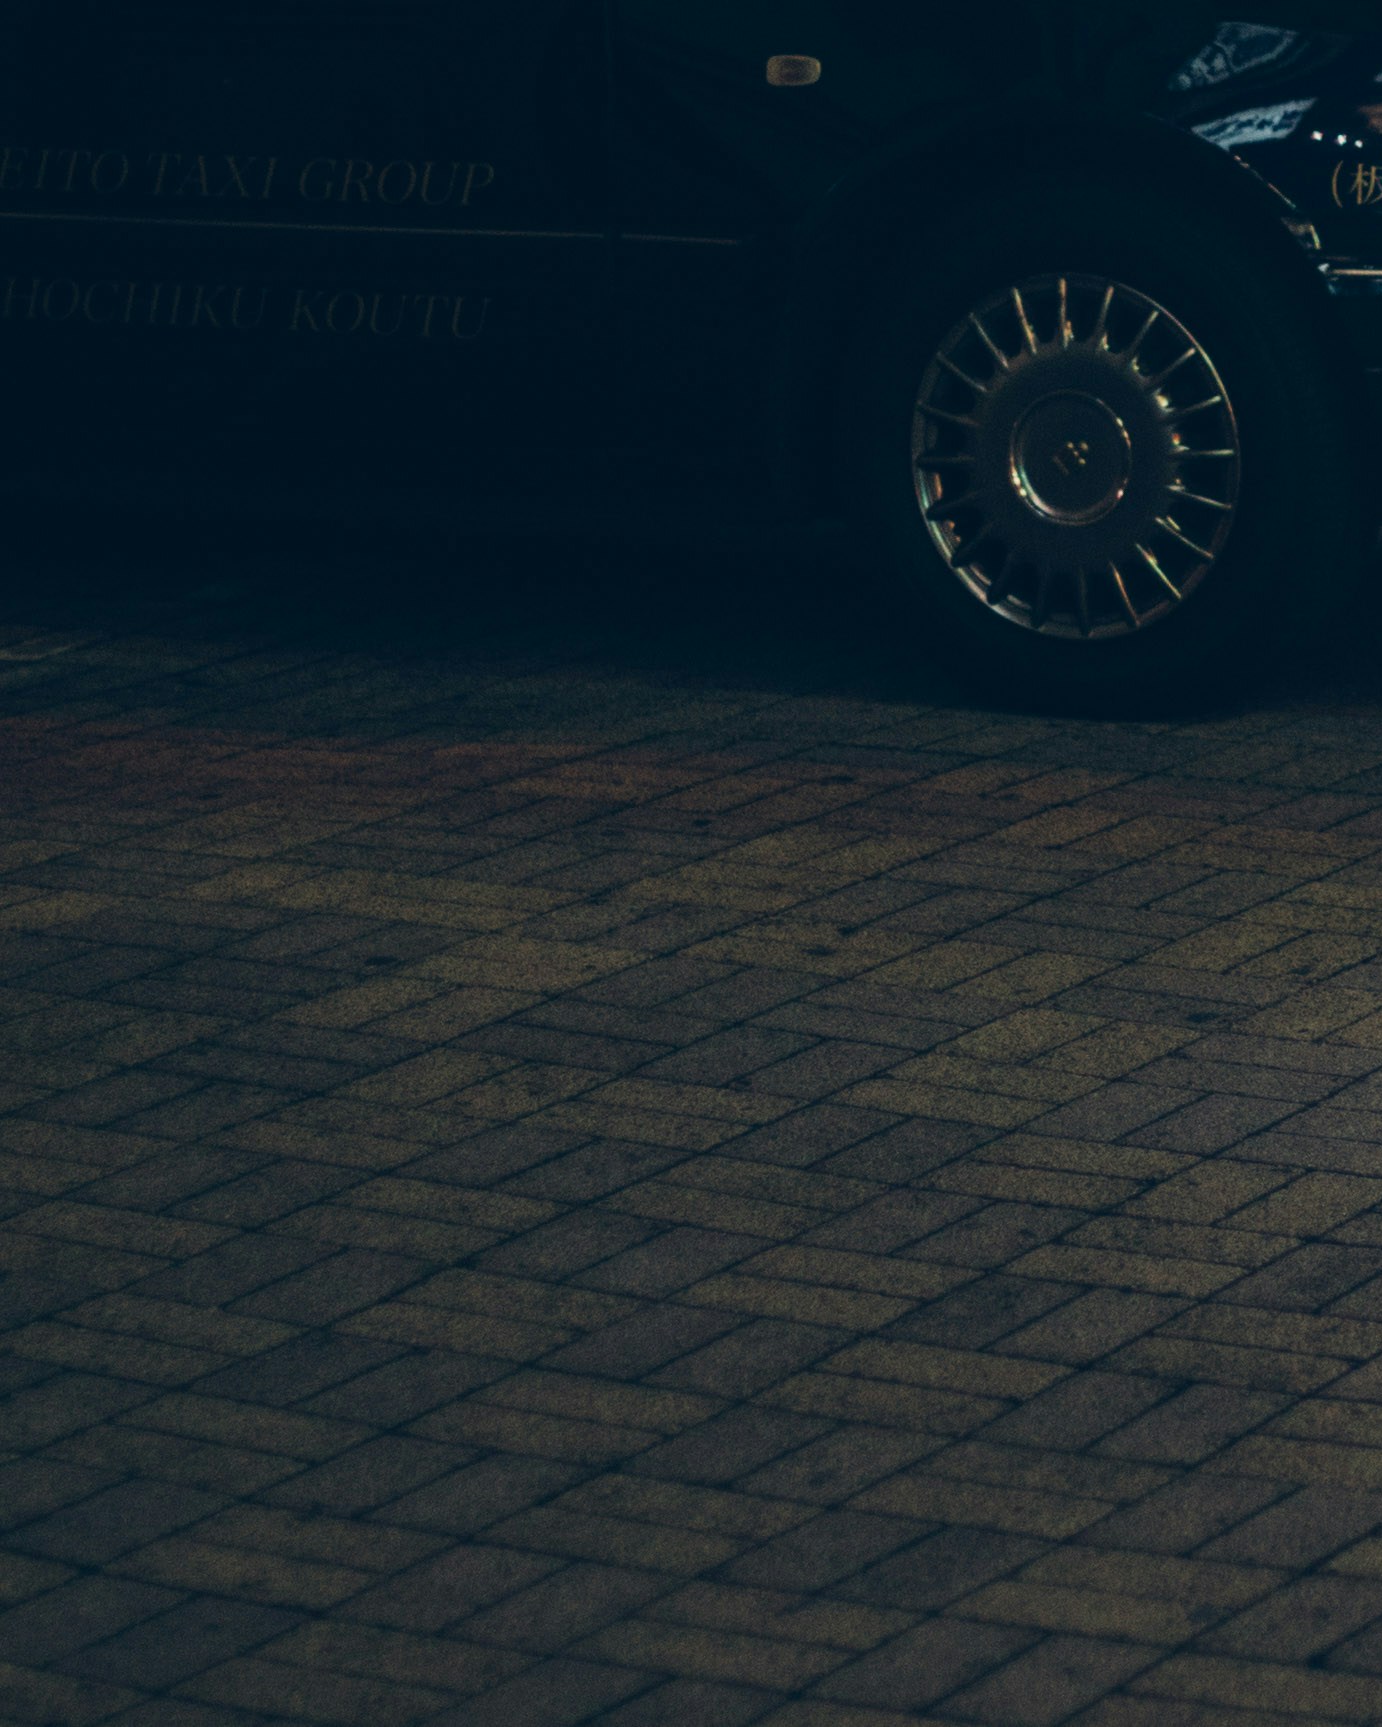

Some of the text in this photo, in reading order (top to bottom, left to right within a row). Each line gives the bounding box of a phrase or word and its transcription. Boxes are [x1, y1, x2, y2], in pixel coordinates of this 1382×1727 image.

[147, 152, 278, 199] TAXI
[297, 157, 496, 206] GROUP
[288, 287, 492, 340] KOUTU
